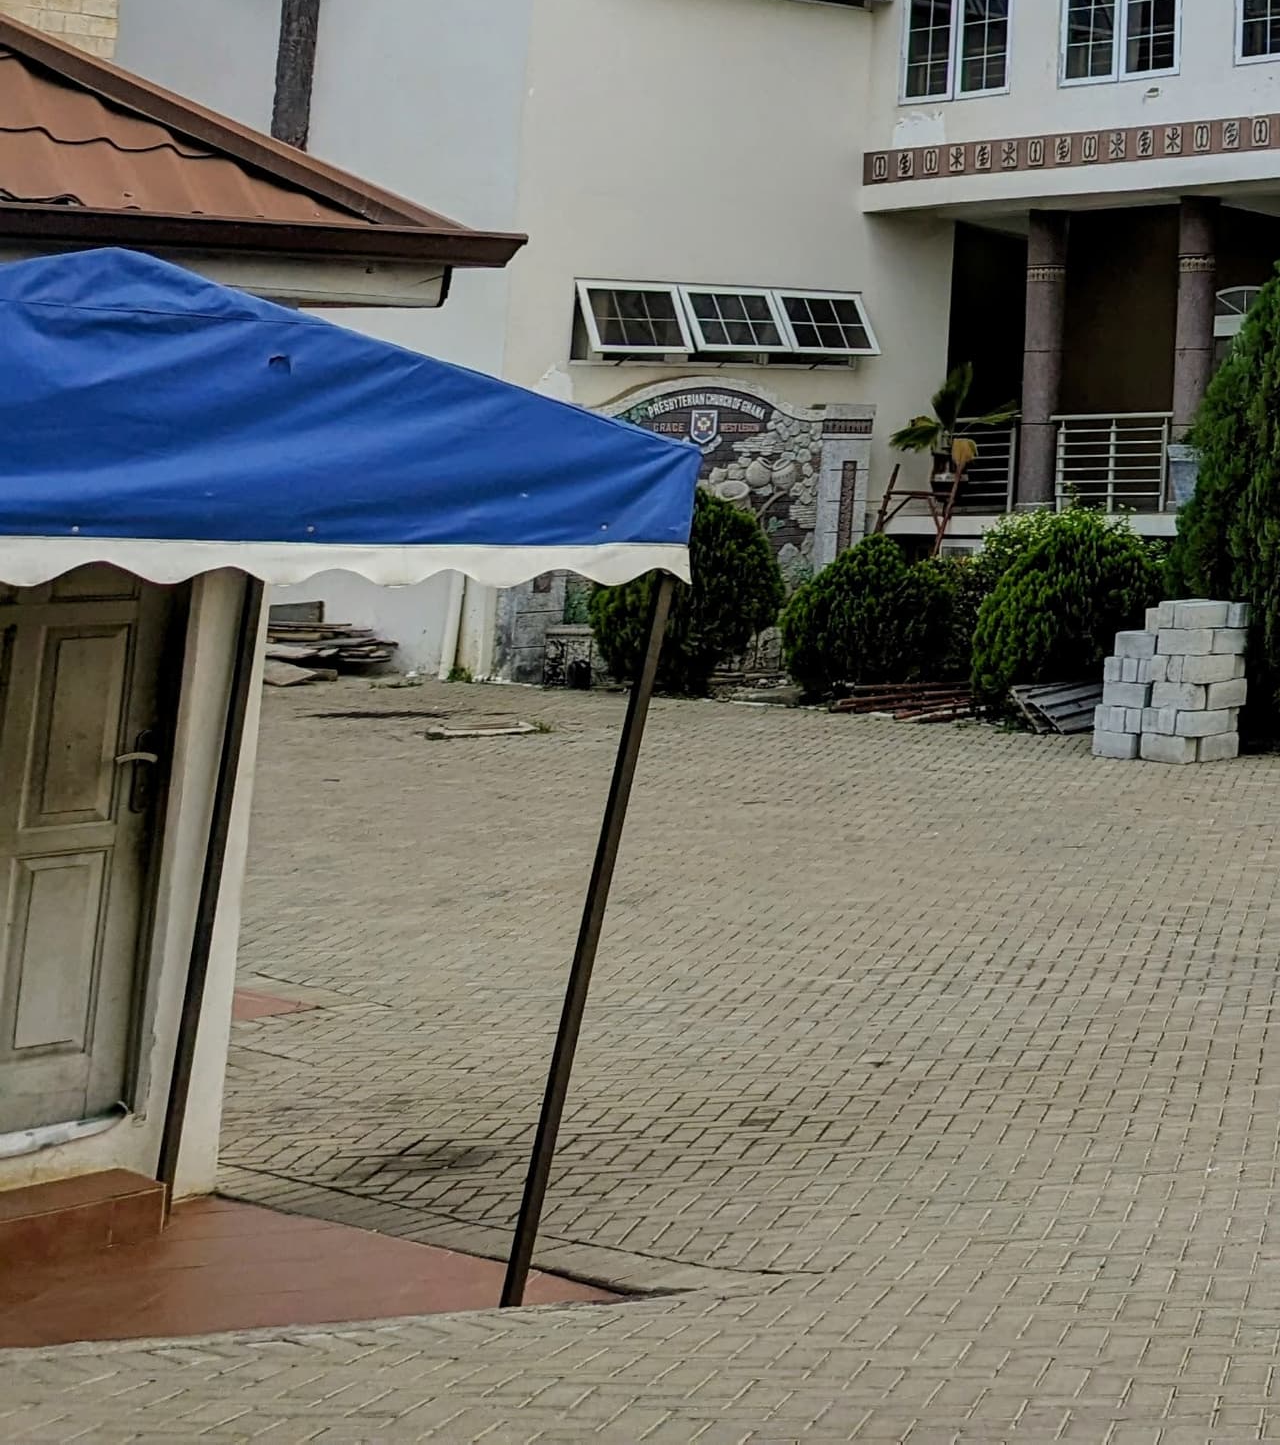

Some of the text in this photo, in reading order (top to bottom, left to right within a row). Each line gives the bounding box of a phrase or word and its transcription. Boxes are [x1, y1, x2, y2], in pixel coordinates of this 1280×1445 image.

[647, 393, 766, 420] PRESBYTERIAN CHURCH OF GHANA
[653, 422, 685, 433] GRACE
